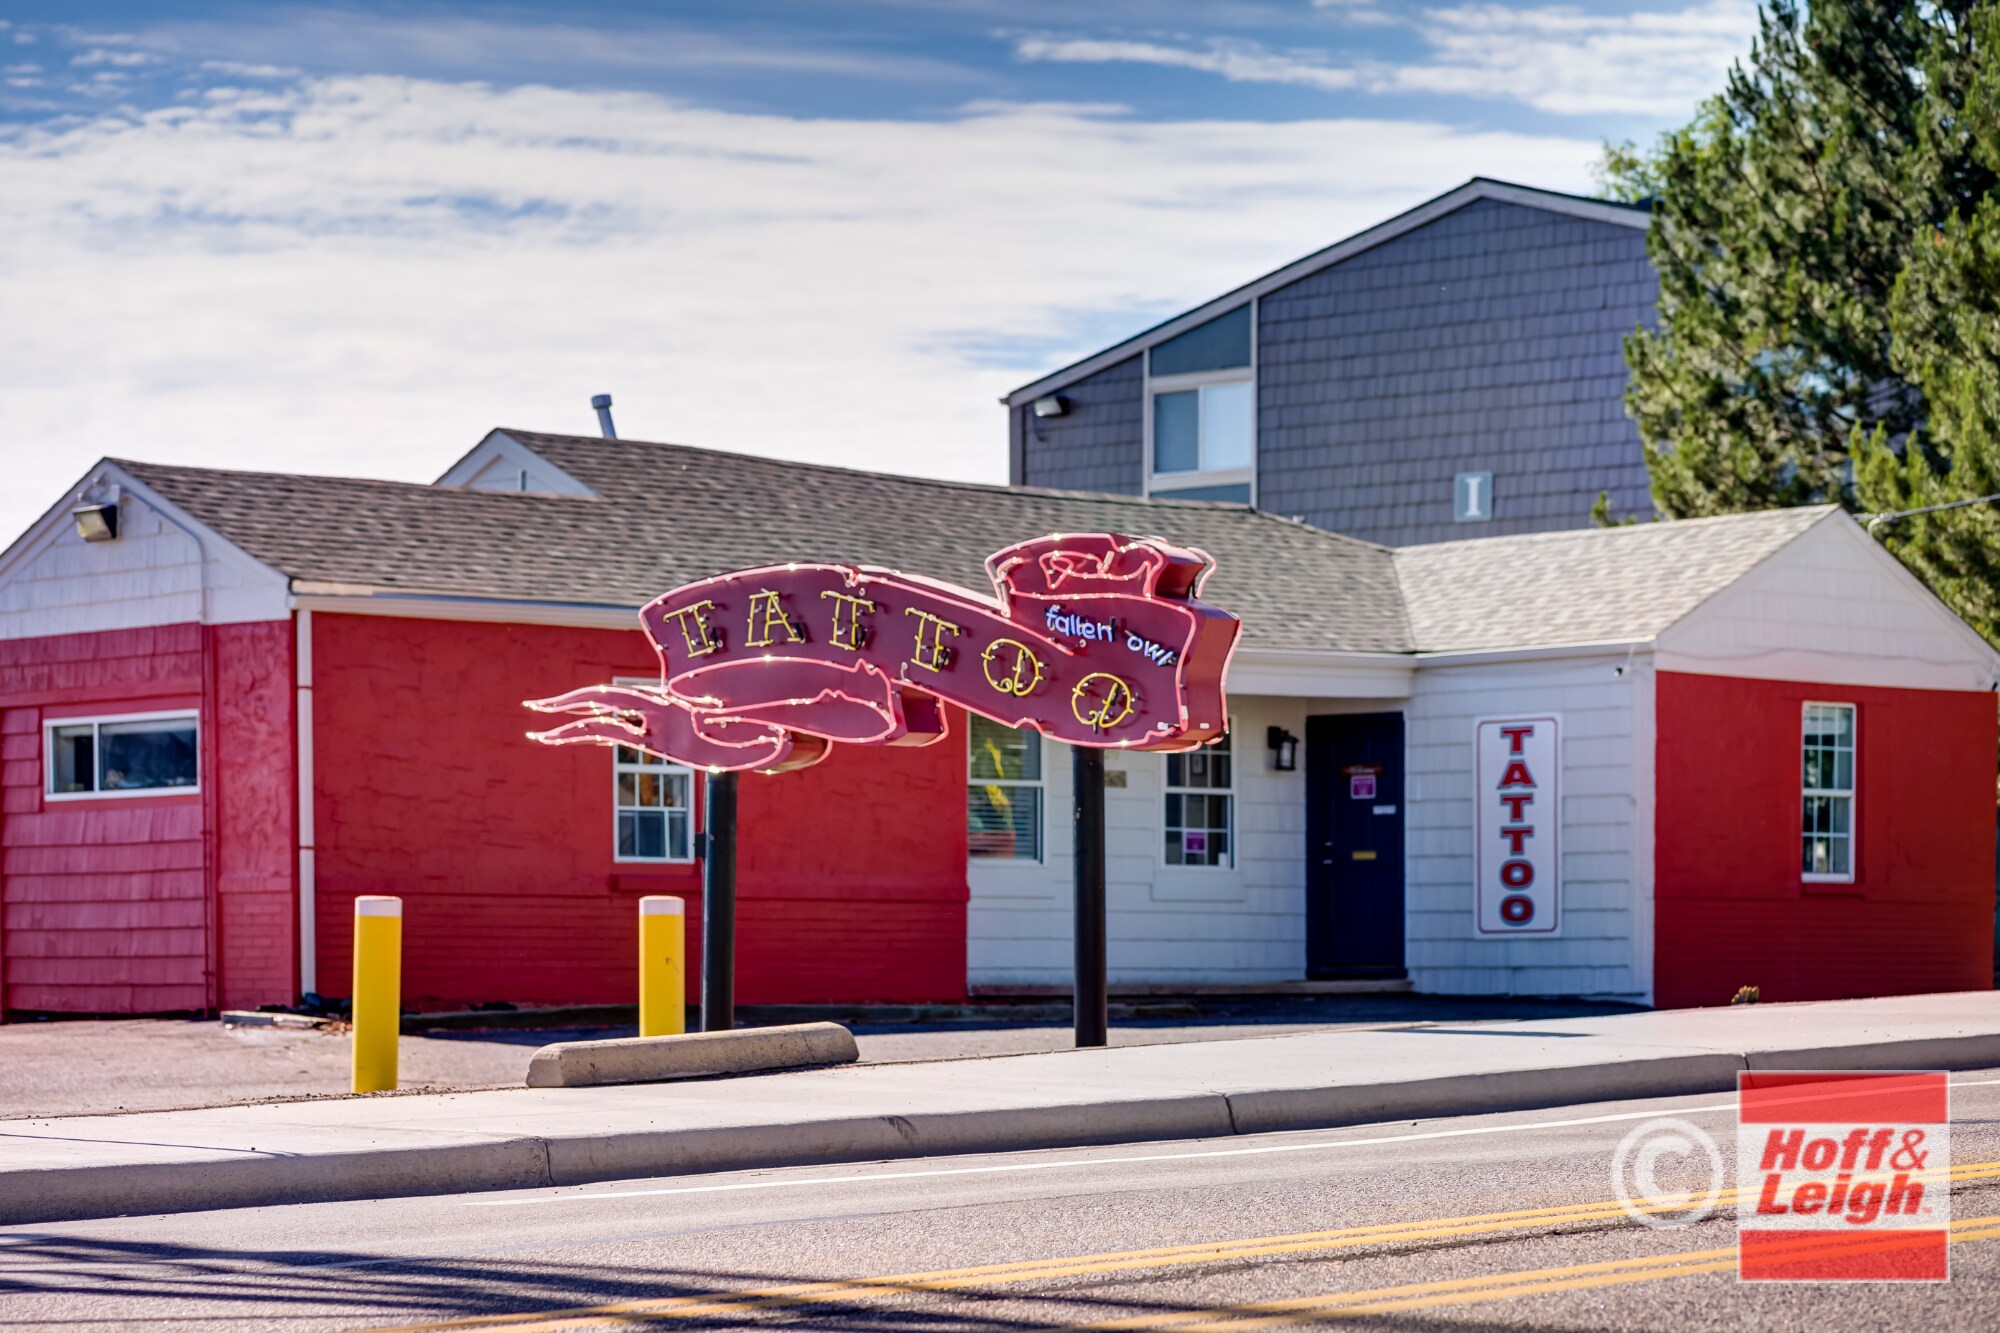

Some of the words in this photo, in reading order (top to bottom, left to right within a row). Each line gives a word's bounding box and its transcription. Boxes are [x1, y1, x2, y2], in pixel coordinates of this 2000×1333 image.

[663, 589, 1137, 729] TATTOO
[1045, 606, 1115, 642] fallen
[1497, 724, 1538, 927] TATTOO
